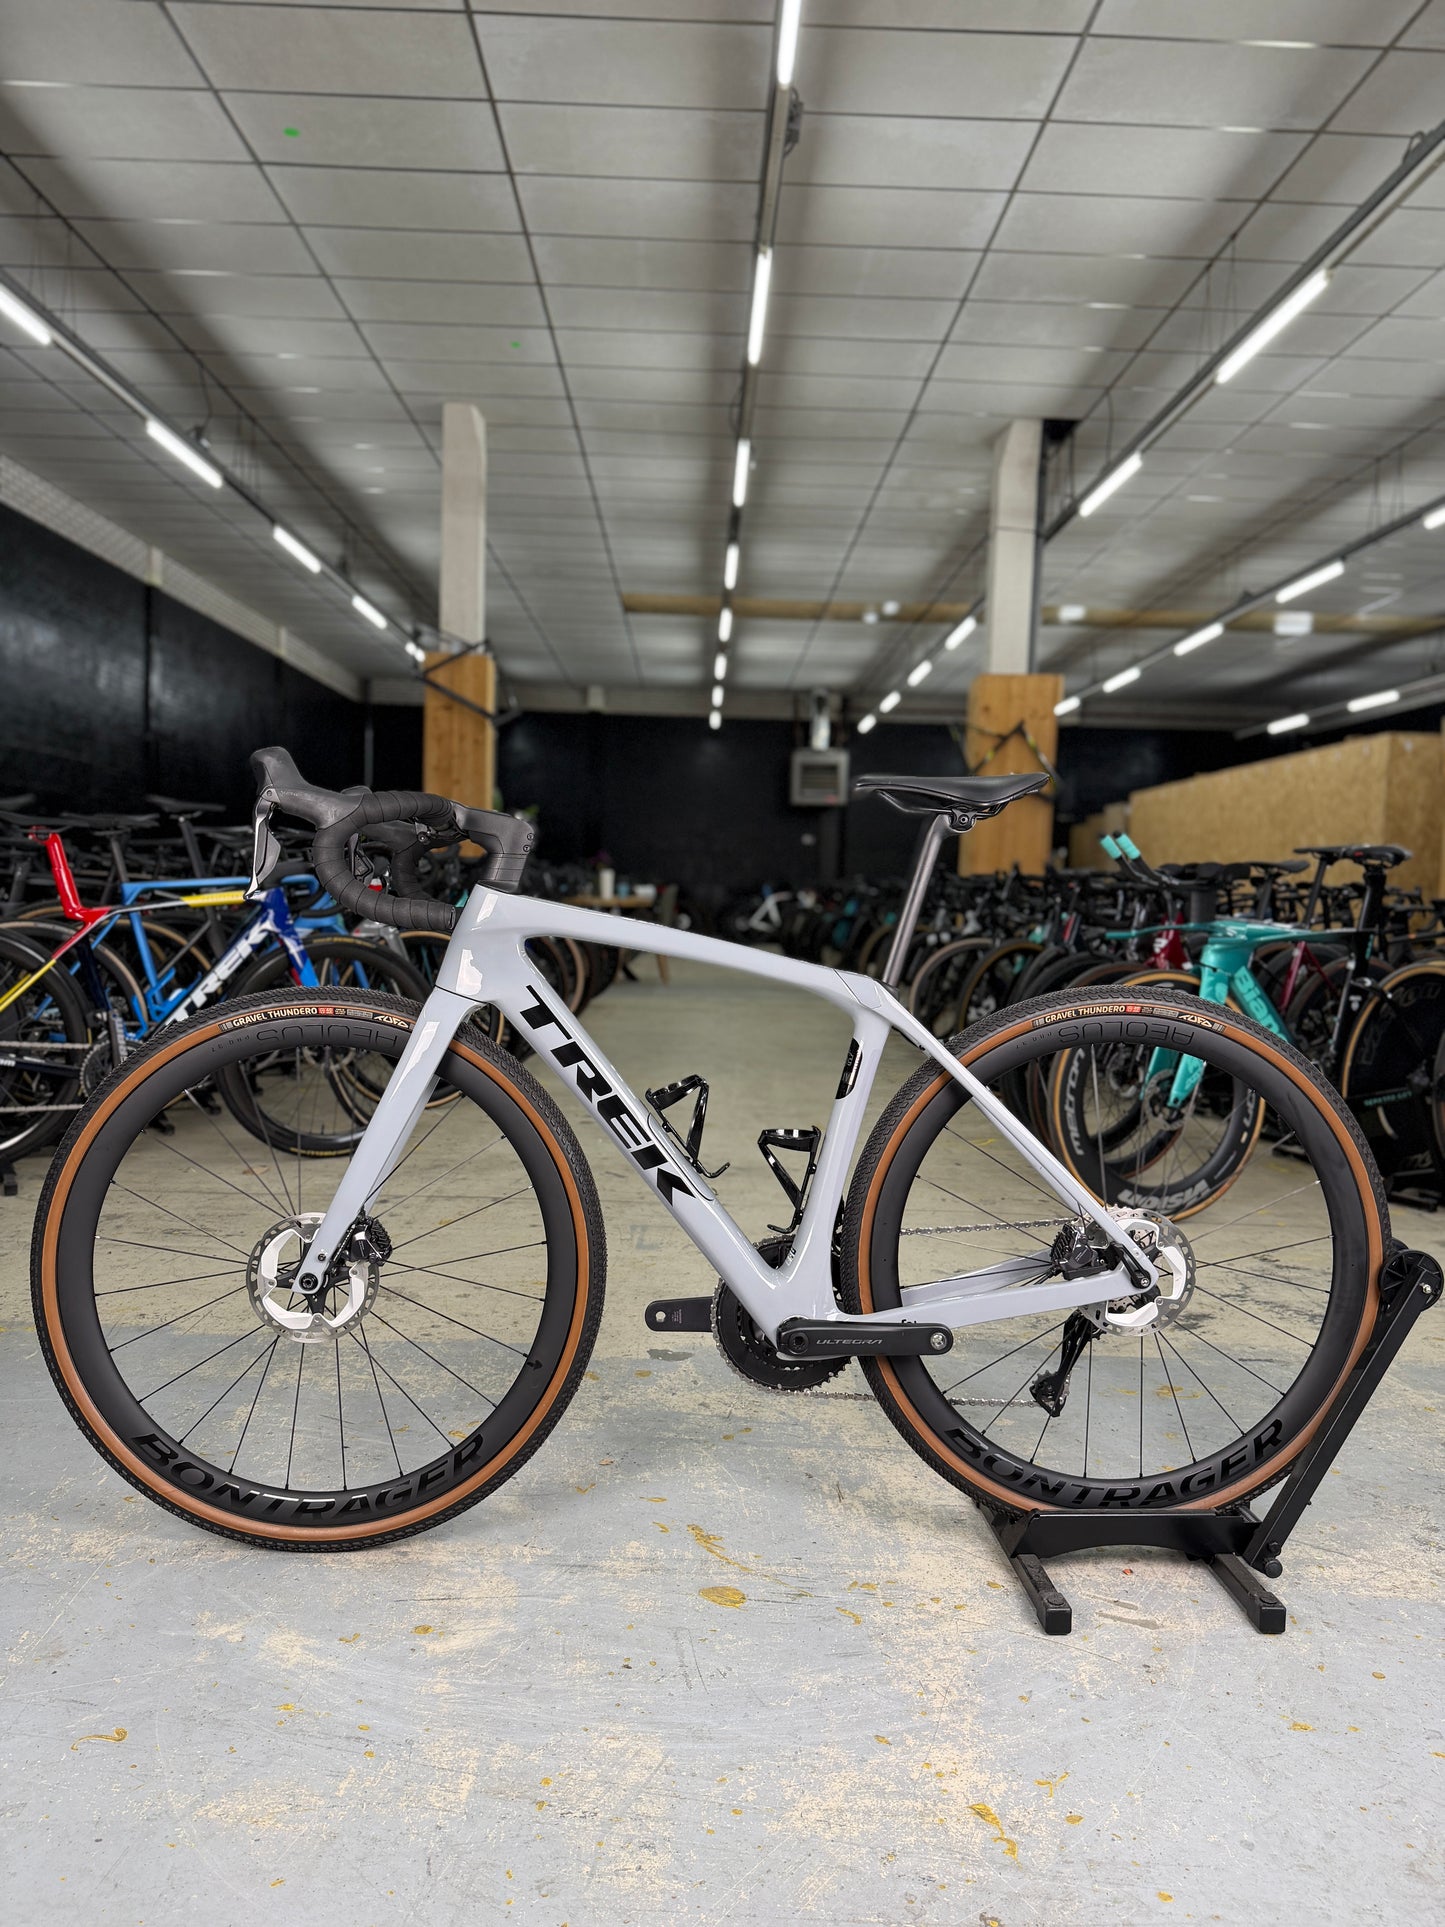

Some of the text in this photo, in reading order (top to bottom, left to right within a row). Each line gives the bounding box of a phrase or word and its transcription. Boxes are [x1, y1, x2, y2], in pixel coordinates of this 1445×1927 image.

[233, 1012, 267, 1027] GRAVEL
[269, 1007, 318, 1018] THUNDERO
[1045, 1010, 1077, 1023] GRAVEL
[1078, 1005, 1125, 1016] THUNDERO
[1058, 1021, 1195, 1045] AEOLUS
[1232, 965, 1290, 1043] Bian
[520, 984, 697, 1207] TREK
[131, 1433, 484, 1520] BONTRAGER
[944, 1418, 1283, 1508] BONTRAGER
